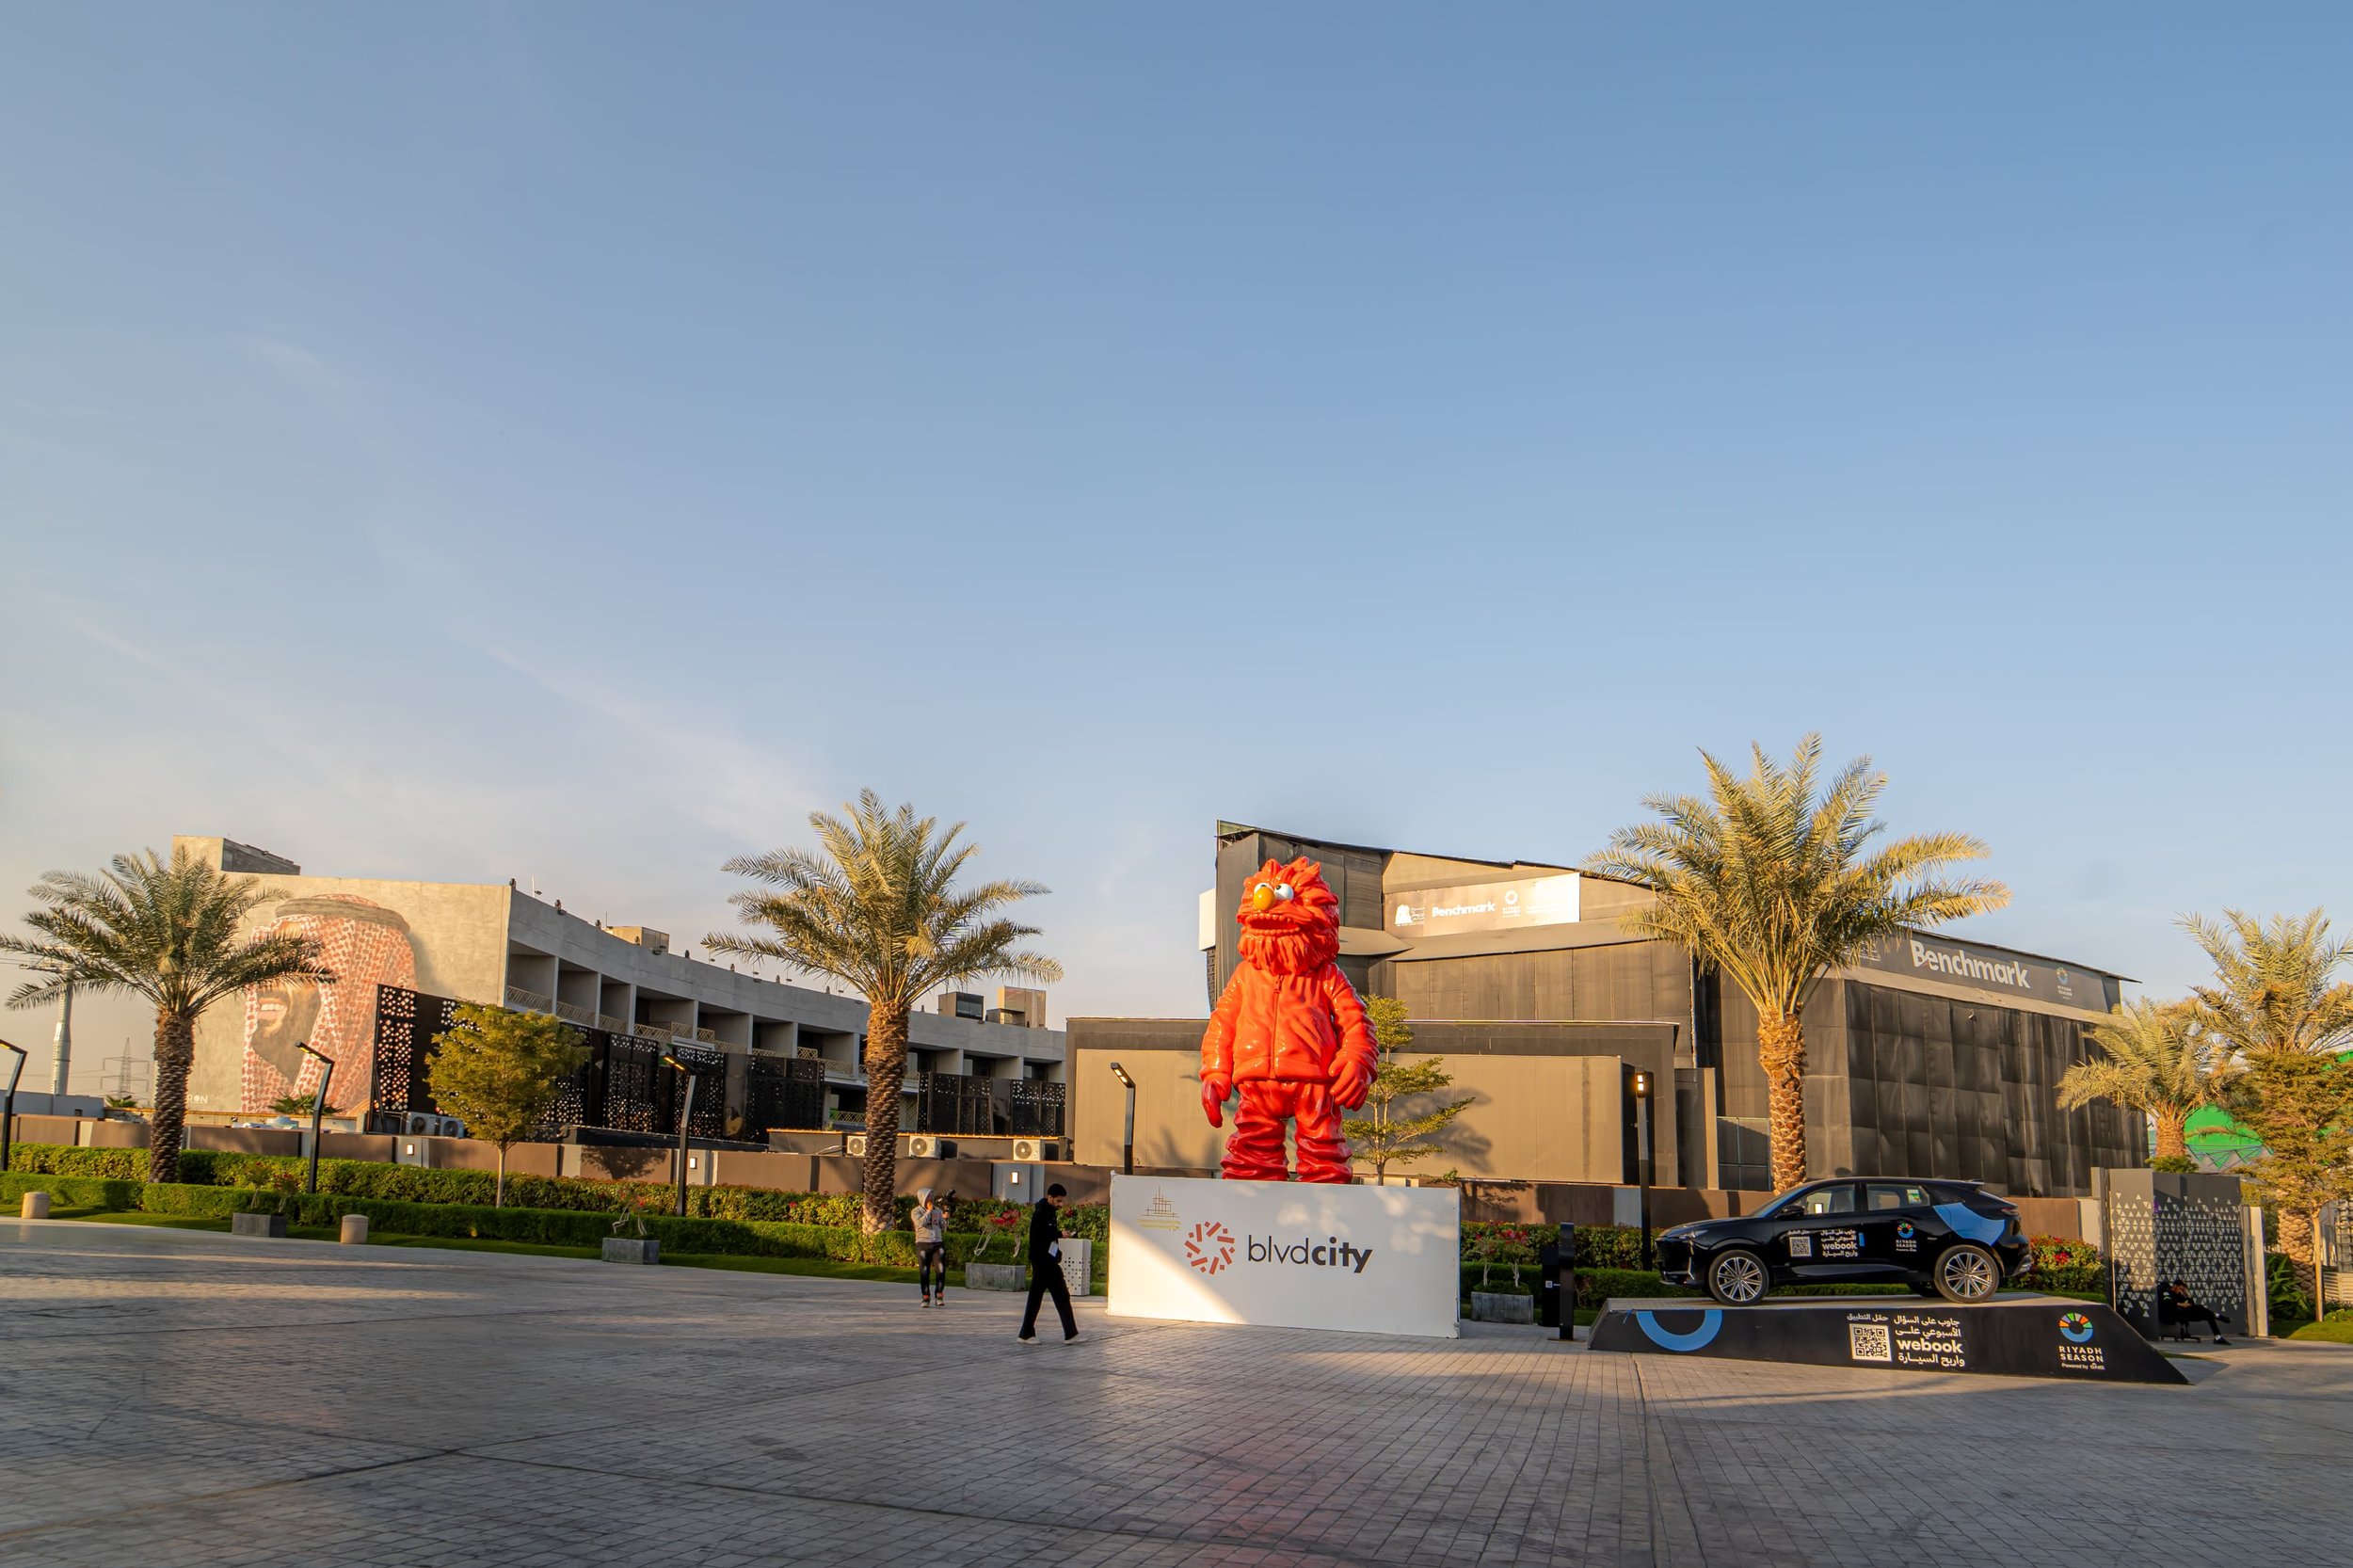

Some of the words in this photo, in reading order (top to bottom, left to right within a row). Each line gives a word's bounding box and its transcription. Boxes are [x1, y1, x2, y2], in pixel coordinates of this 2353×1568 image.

[1433, 902, 1496, 918] Benchmark
[1910, 940, 2031, 989] Benchmark
[1821, 1241, 1858, 1250] webook
[1248, 1235, 1373, 1273] blvdcity
[1894, 1315, 1920, 1324] السؤال
[1921, 1317, 1936, 1326] على
[1938, 1318, 1961, 1328] جاوب
[1897, 1337, 1964, 1353] webook
[2058, 1346, 2103, 1354] RIYADH
[1941, 1355, 1965, 1367] واربح
[2060, 1353, 2105, 1362] SEASON
